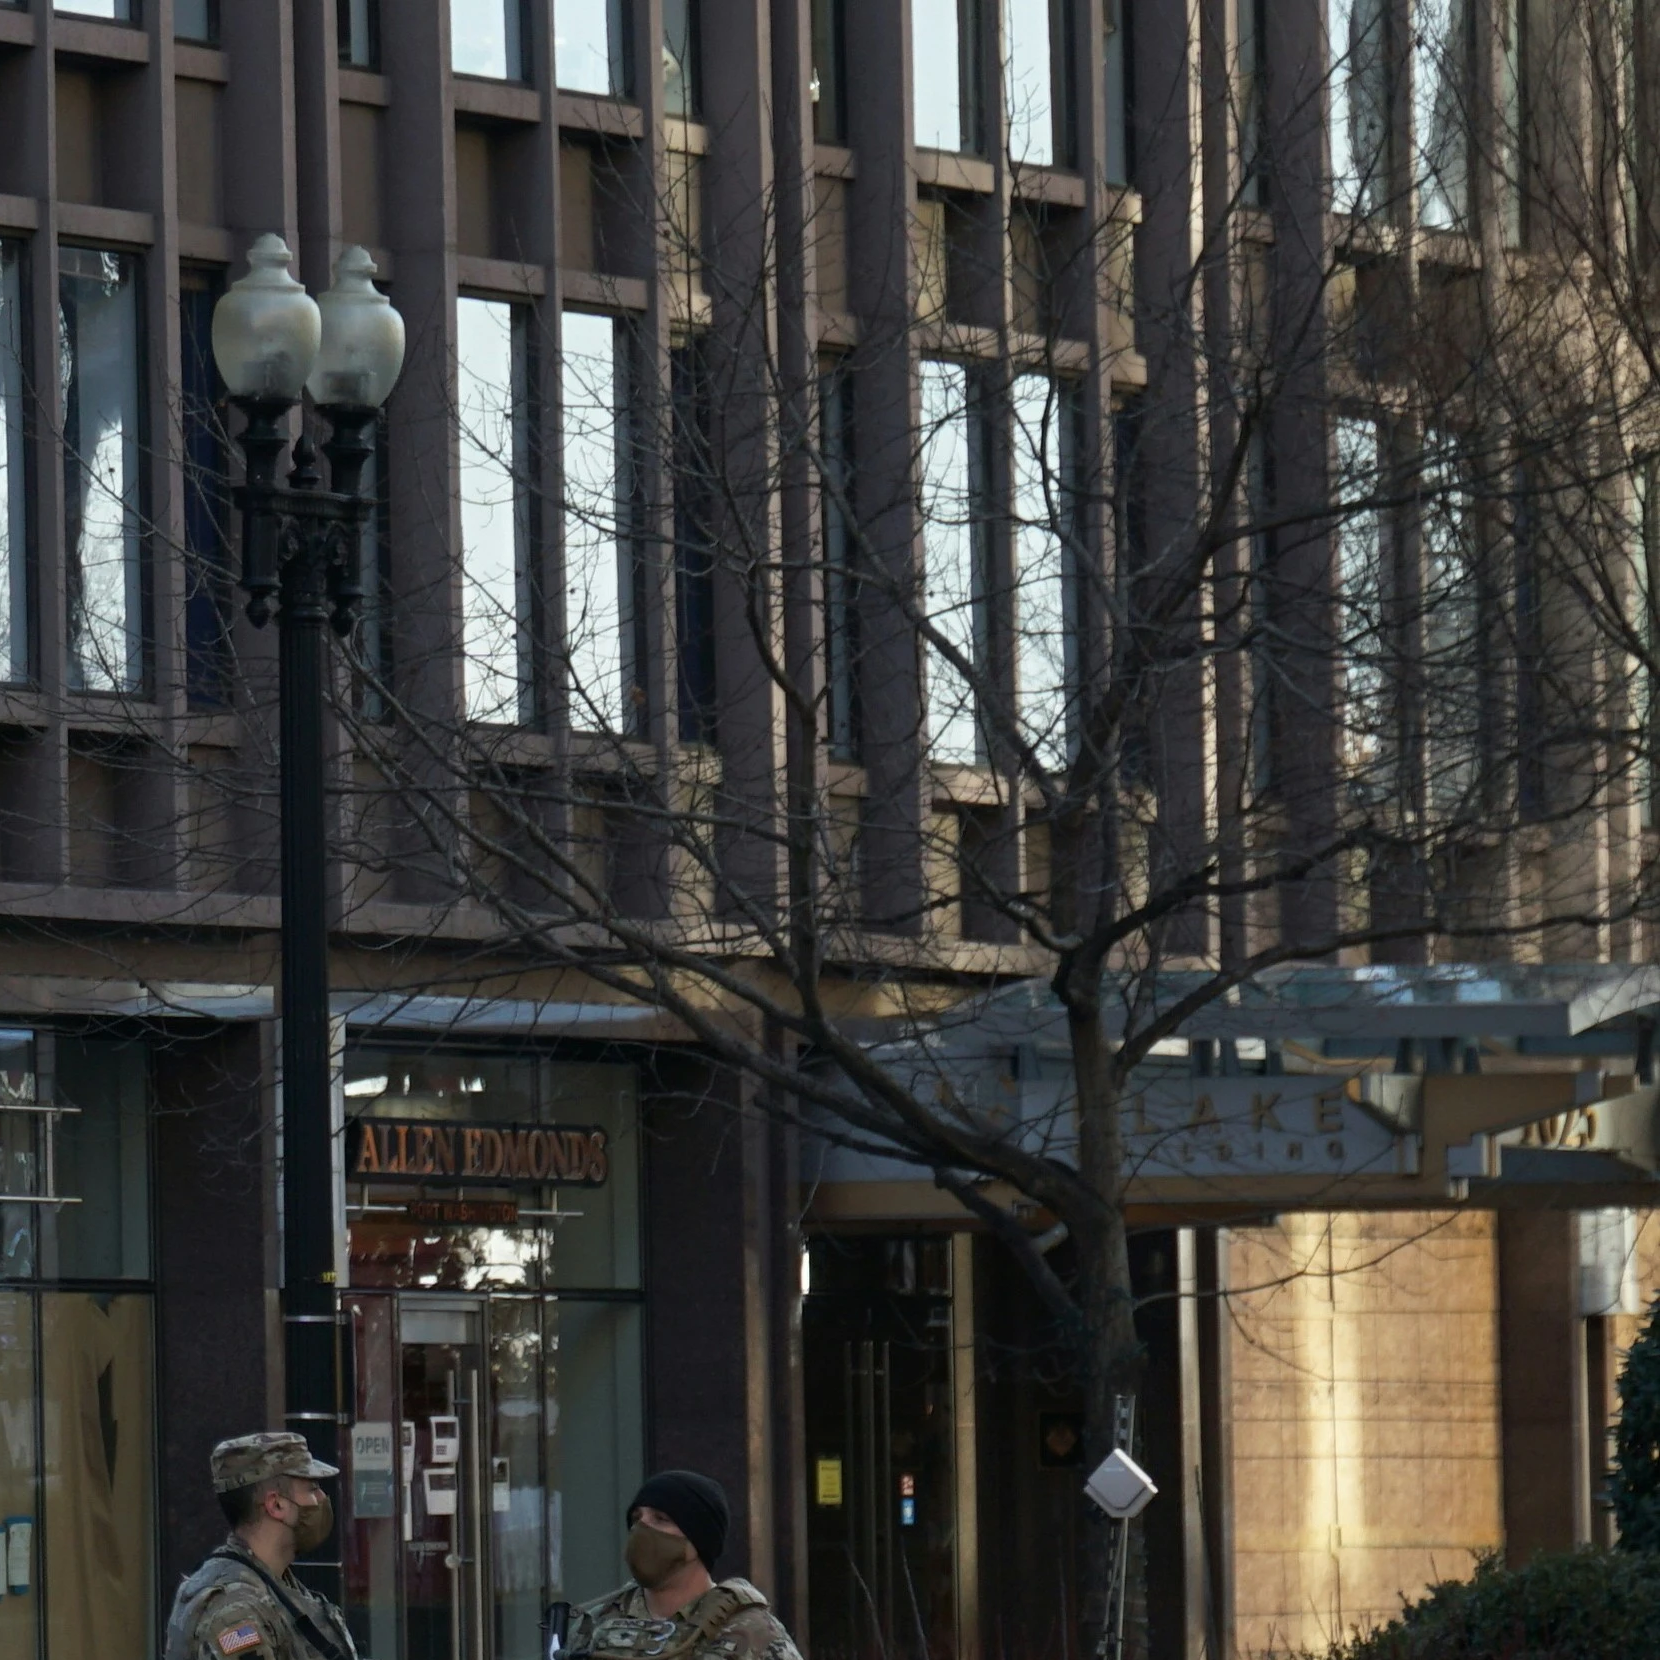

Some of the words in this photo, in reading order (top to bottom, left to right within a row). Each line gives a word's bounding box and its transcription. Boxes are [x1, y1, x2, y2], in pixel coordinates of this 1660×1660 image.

[1072, 1093, 1344, 1134] LAKE
[356, 1124, 456, 1176] ALLEN
[462, 1127, 609, 1183] EDMONDS
[355, 1436, 390, 1454] OPEN
